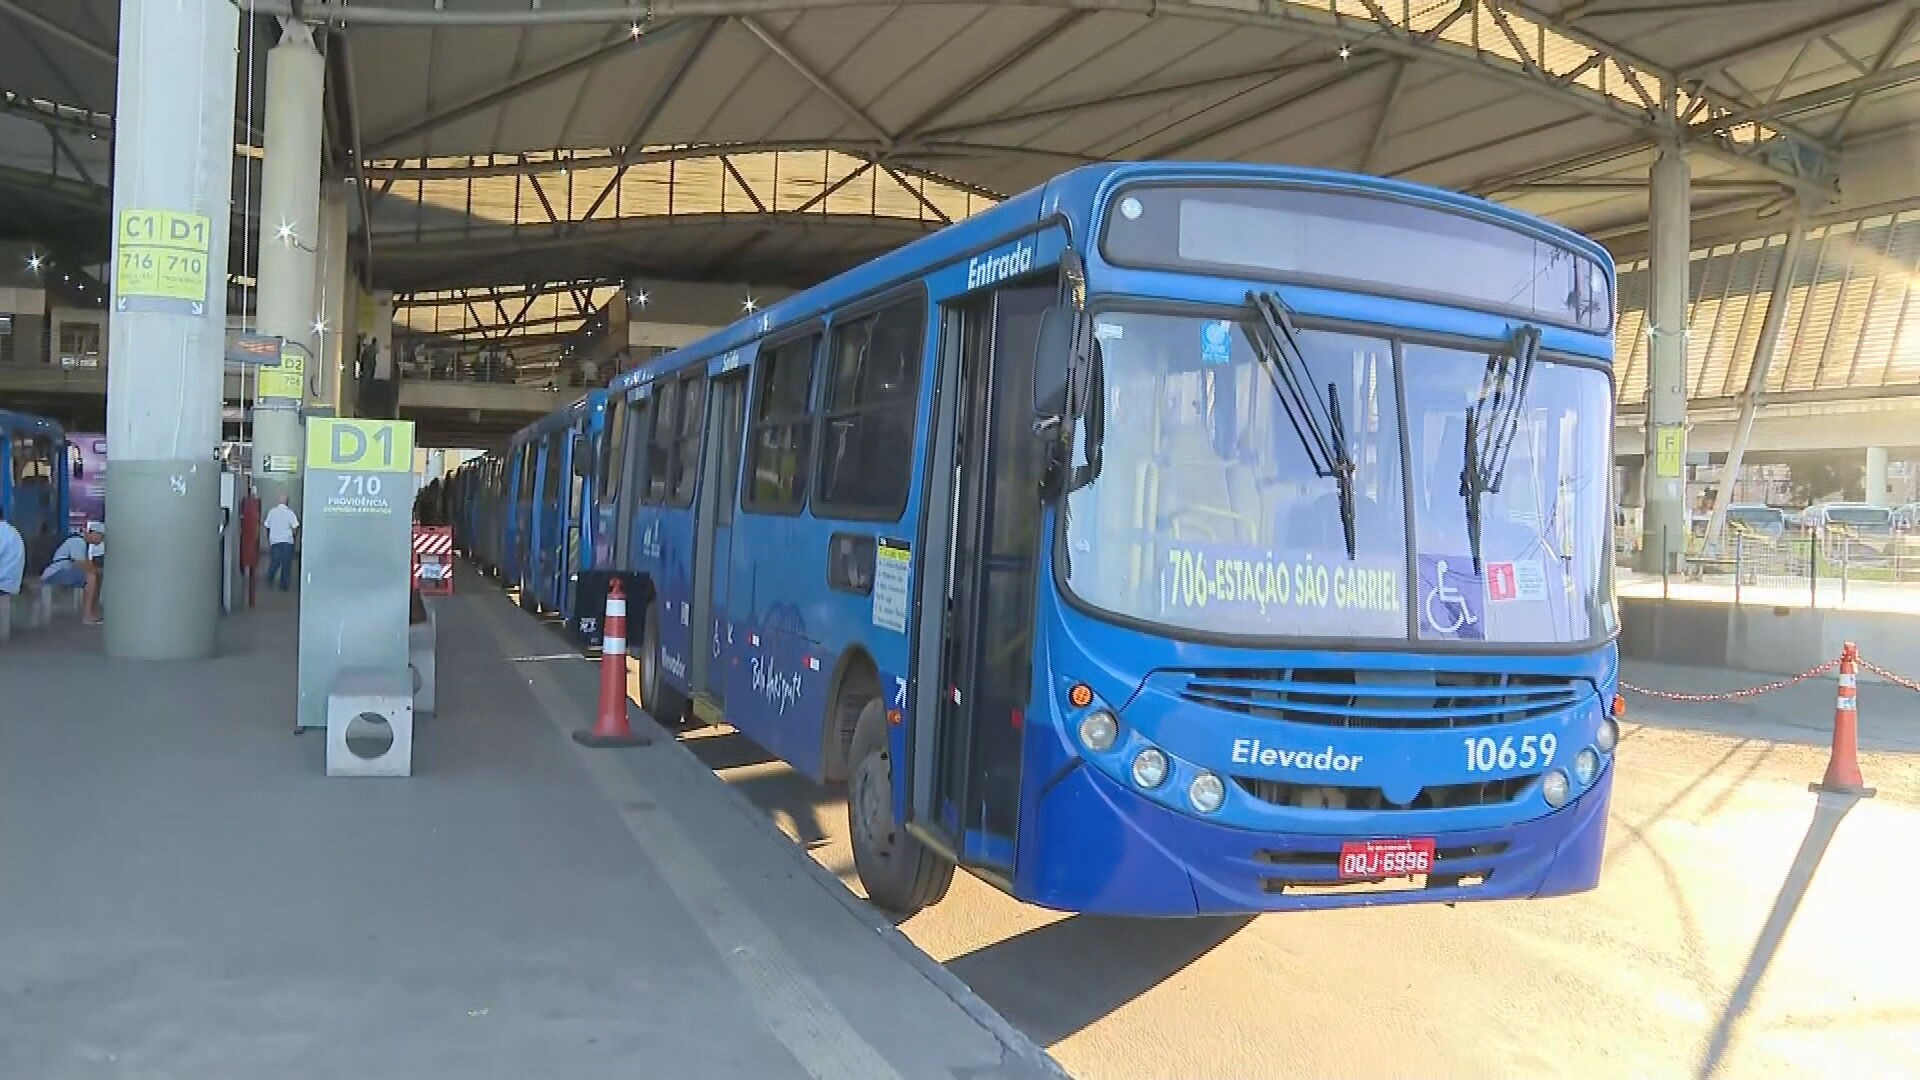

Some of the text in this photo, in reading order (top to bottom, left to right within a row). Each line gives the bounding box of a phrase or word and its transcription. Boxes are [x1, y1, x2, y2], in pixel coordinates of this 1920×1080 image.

[126, 216, 154, 239] C1
[170, 217, 204, 243] D1
[123, 253, 153, 270] 716
[167, 255, 202, 275] 710
[967, 240, 1032, 291] Entrada
[284, 357, 302, 371] D2
[331, 423, 393, 466] D1
[337, 475, 382, 496] 710
[328, 496, 388, 507] PROVIDÊNCIA
[1169, 549, 1400, 615] 706-ESTAÇÃO SÃO GABRIEL
[1231, 738, 1364, 772] Elevador
[1463, 732, 1558, 772] 10659
